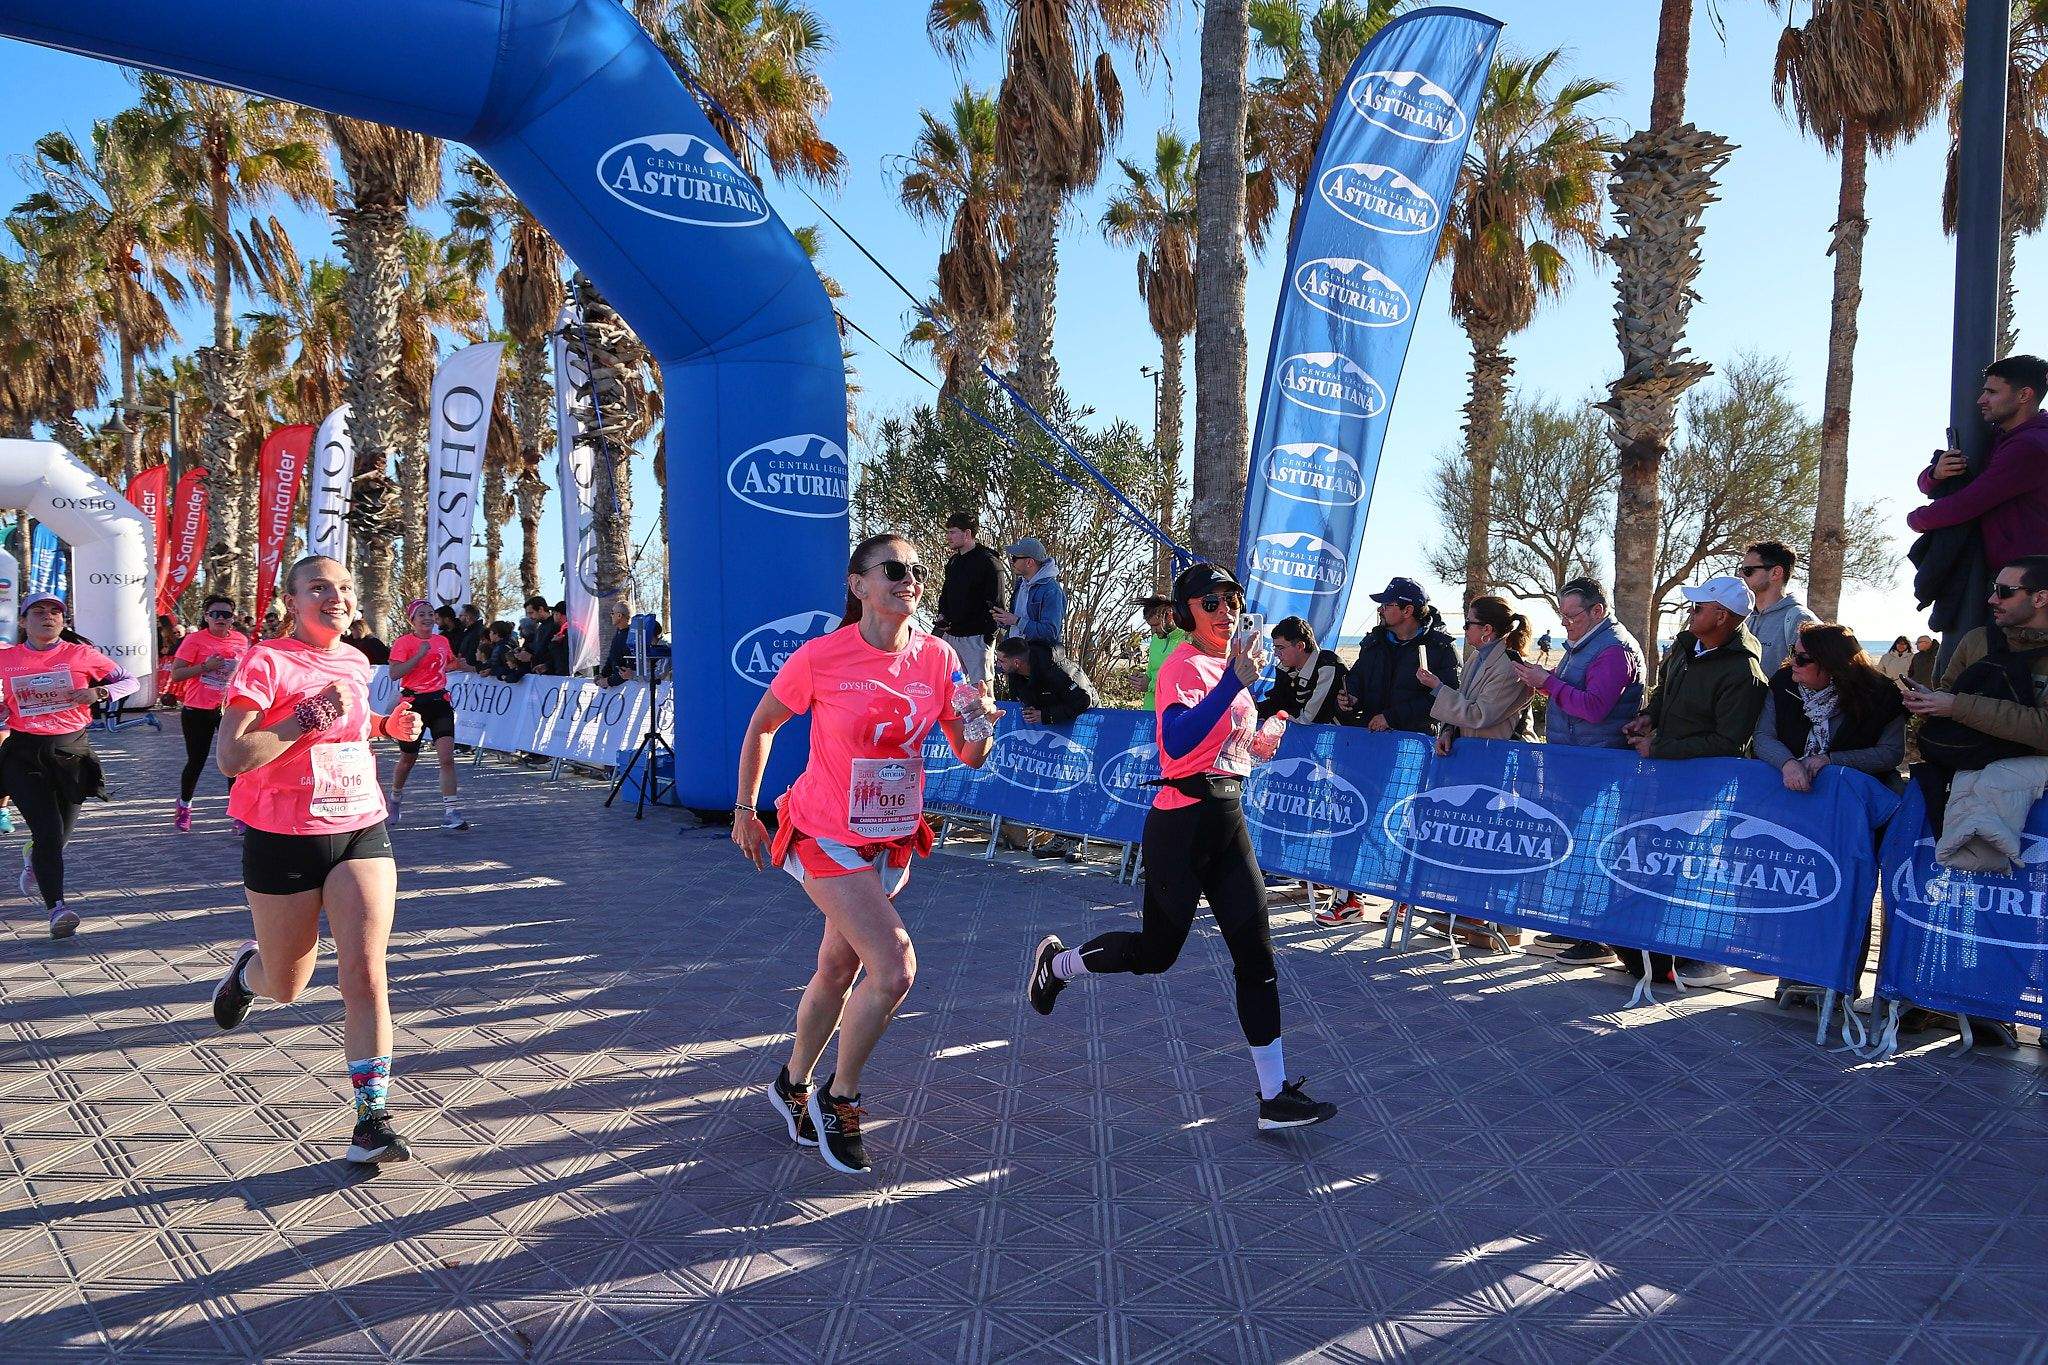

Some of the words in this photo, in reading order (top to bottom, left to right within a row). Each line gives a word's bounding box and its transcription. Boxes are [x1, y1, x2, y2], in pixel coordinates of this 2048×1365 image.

[1357, 82, 1454, 138] ASTURIANA
[647, 156, 706, 175] CENTRAL
[612, 155, 765, 216] ASTURIANA
[1327, 174, 1428, 229] ASTURIANA
[1350, 176, 1388, 198] CENTRAL
[1390, 190, 1431, 210] LECHERA
[1301, 268, 1400, 321] ASTURIANA
[1362, 283, 1400, 302] LECHERA
[1282, 365, 1376, 414] ASTURIANA
[1301, 366, 1341, 381] CENTRAL
[741, 461, 848, 500] ASTURIAN
[769, 459, 820, 471] CENTRAL
[1267, 456, 1358, 499] ASTURIANA
[52, 497, 116, 511] OYSHO
[268, 450, 297, 548] Santander
[436, 385, 485, 606] OYSHO
[176, 486, 205, 564] Santander
[1250, 545, 1343, 587] ASTURIANA
[1265, 548, 1306, 561] CENTRAL
[450, 682, 513, 716] OYSHO
[839, 681, 878, 691] OYSHO
[541, 686, 627, 727] OYSHO
[342, 774, 362, 788] 016
[993, 743, 1086, 782] ASTURIANA
[879, 793, 906, 807] 016
[857, 826, 884, 834] OYSHO
[1394, 803, 1555, 861] ASTURIANA
[1426, 808, 1482, 824] CENTRAL
[1487, 815, 1553, 834] LECHERA
[1612, 836, 1820, 900] ASTURIANA
[1652, 836, 1724, 859] CENTRAL
[1733, 844, 1818, 868] LECHERA
[1891, 856, 2048, 920] ASTURI
